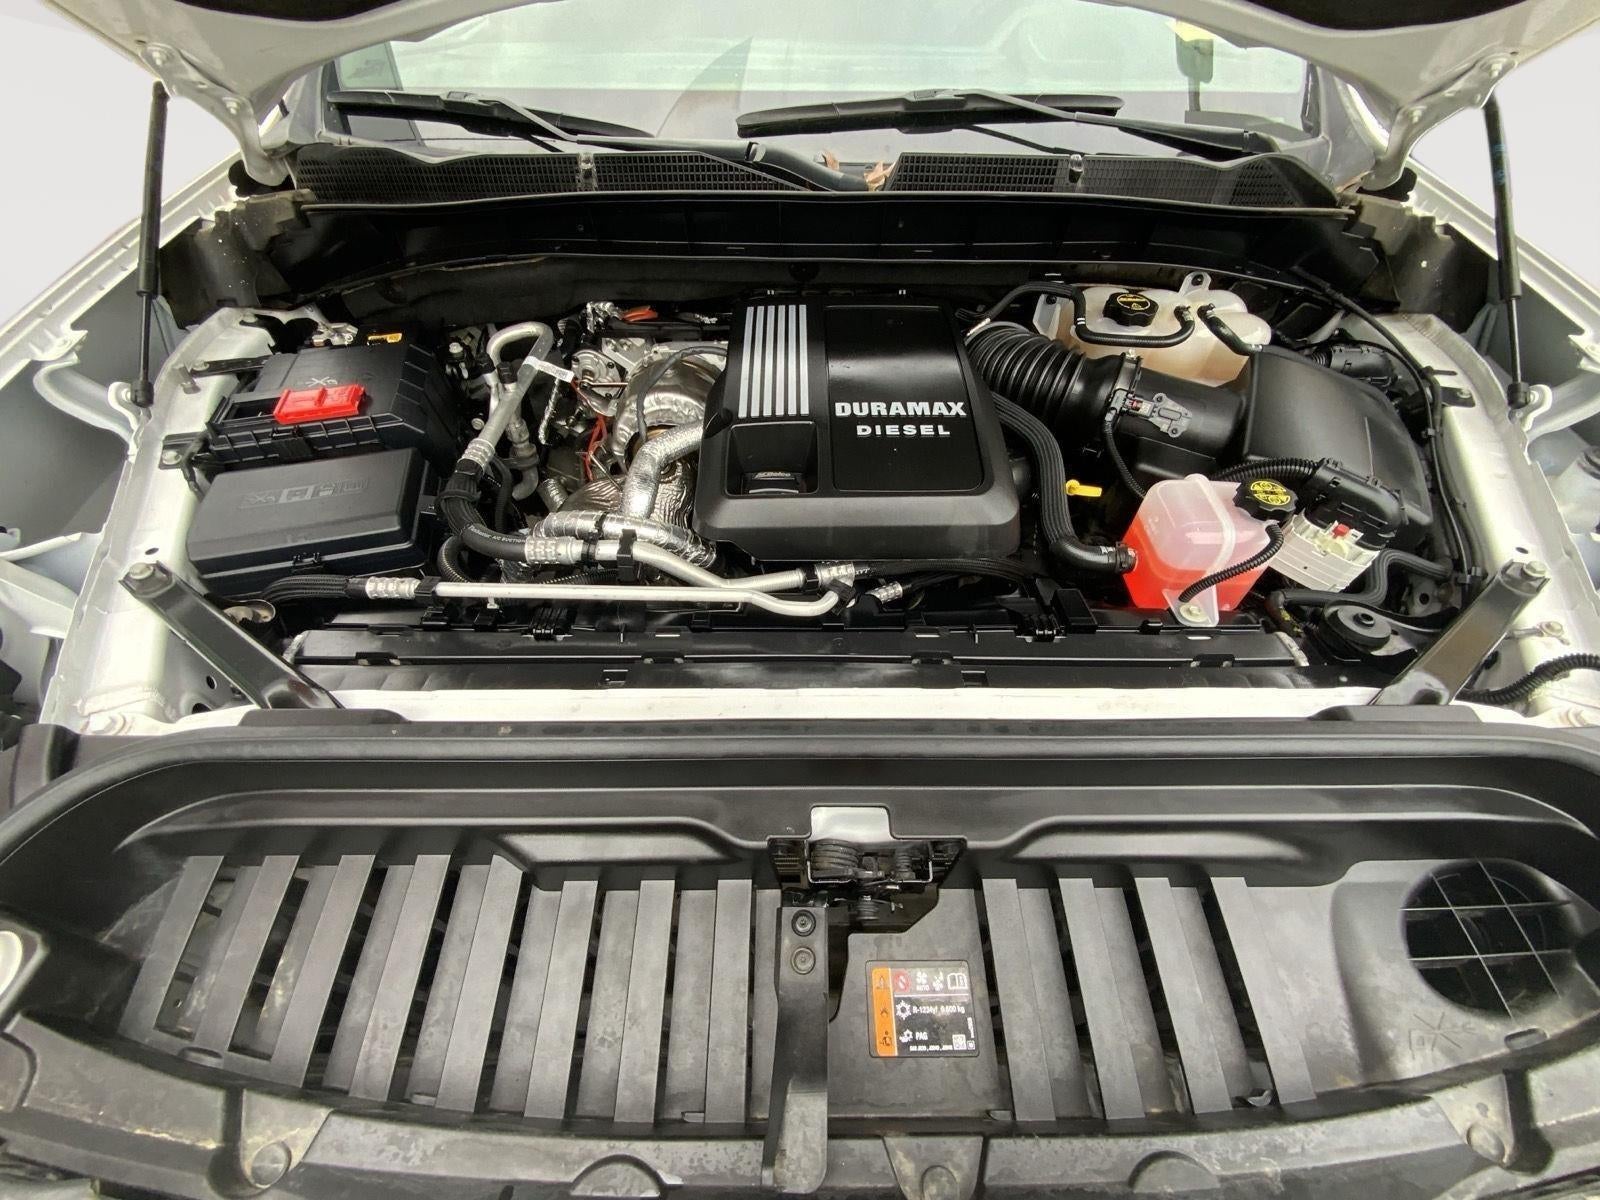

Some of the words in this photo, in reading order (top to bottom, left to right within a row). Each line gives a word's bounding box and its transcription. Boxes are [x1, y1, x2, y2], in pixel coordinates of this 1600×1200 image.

[835, 402, 966, 416] DURAMAX
[857, 425, 950, 435] DIESEL
[915, 1032, 928, 1040] PAG
